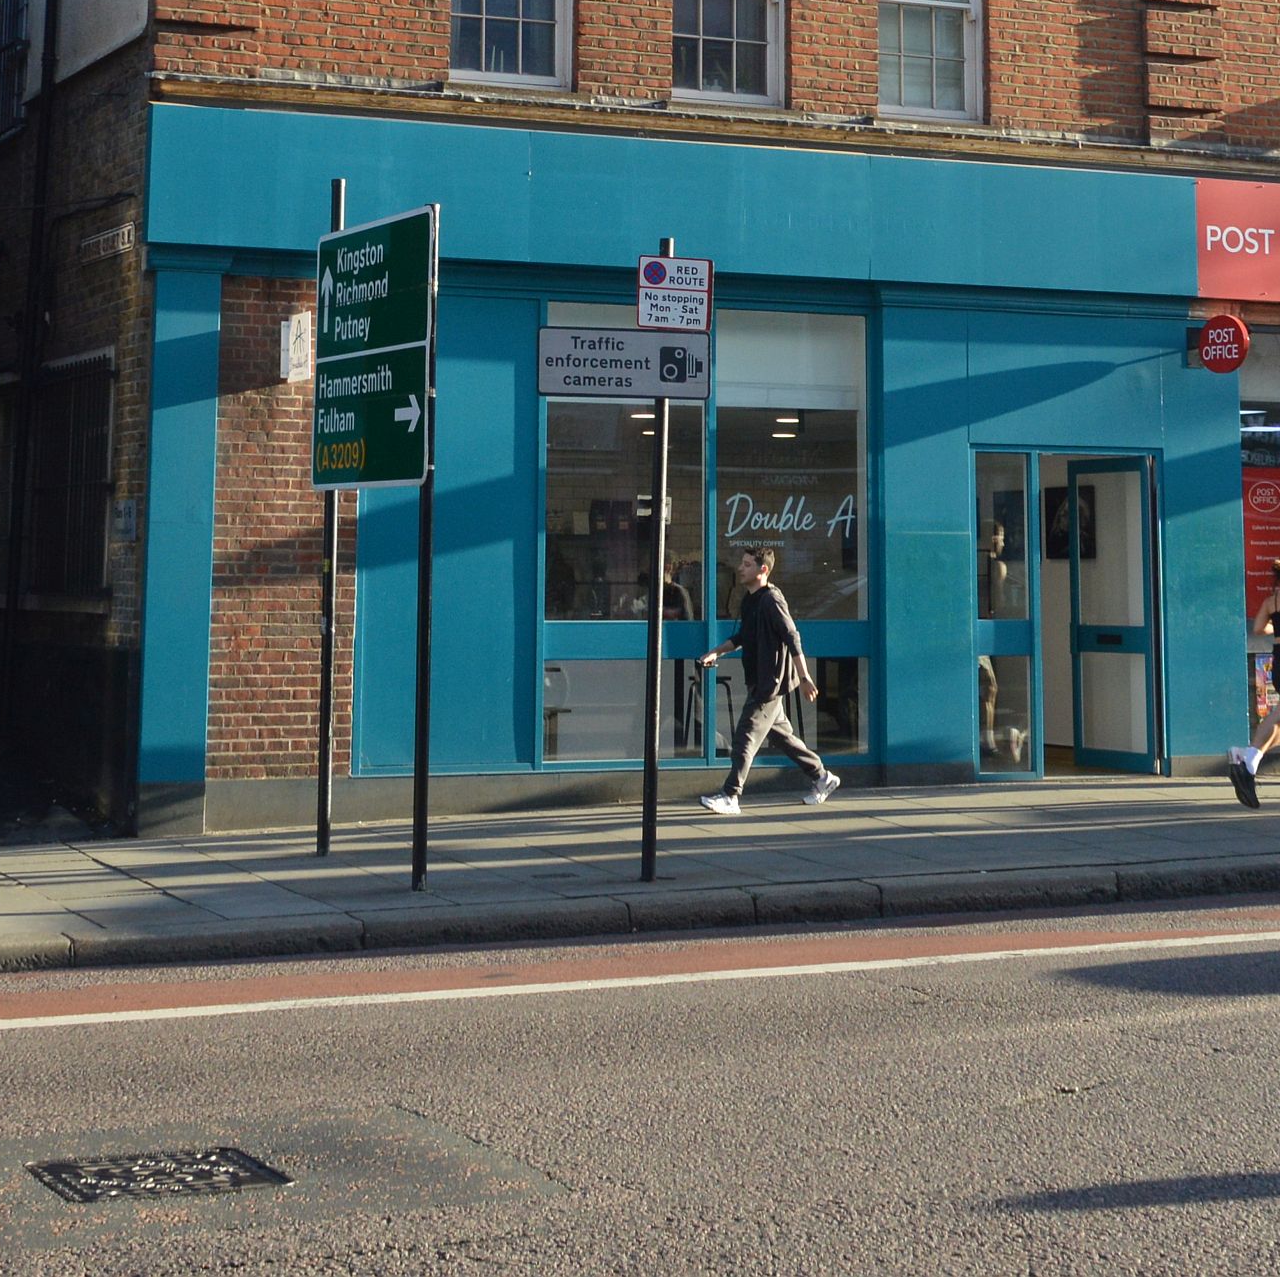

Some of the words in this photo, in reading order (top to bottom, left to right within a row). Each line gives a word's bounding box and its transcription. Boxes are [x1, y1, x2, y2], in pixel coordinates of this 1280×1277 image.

[1206, 225, 1275, 255] POST
[336, 241, 384, 275] Kingston
[676, 266, 698, 275] RED
[335, 270, 389, 307] Richmond
[669, 276, 705, 286] ROUTE
[644, 292, 659, 301] No
[662, 294, 704, 305] stopping
[650, 303, 671, 312] Mon
[681, 305, 698, 314] Sat
[334, 314, 371, 342] Putney
[1208, 327, 1235, 344] POST
[571, 335, 624, 351] Traffic
[1202, 344, 1239, 360] OFFICE
[545, 354, 651, 370] enforcement
[319, 364, 393, 399] Hammersmith
[563, 374, 633, 387] cameras
[317, 407, 355, 434] Fulham
[316, 437, 366, 473] (A3209)
[1252, 496, 1278, 504] OFFICE
[1256, 488, 1275, 496] POST
[724, 492, 817, 537] Double
[827, 494, 856, 538] A
